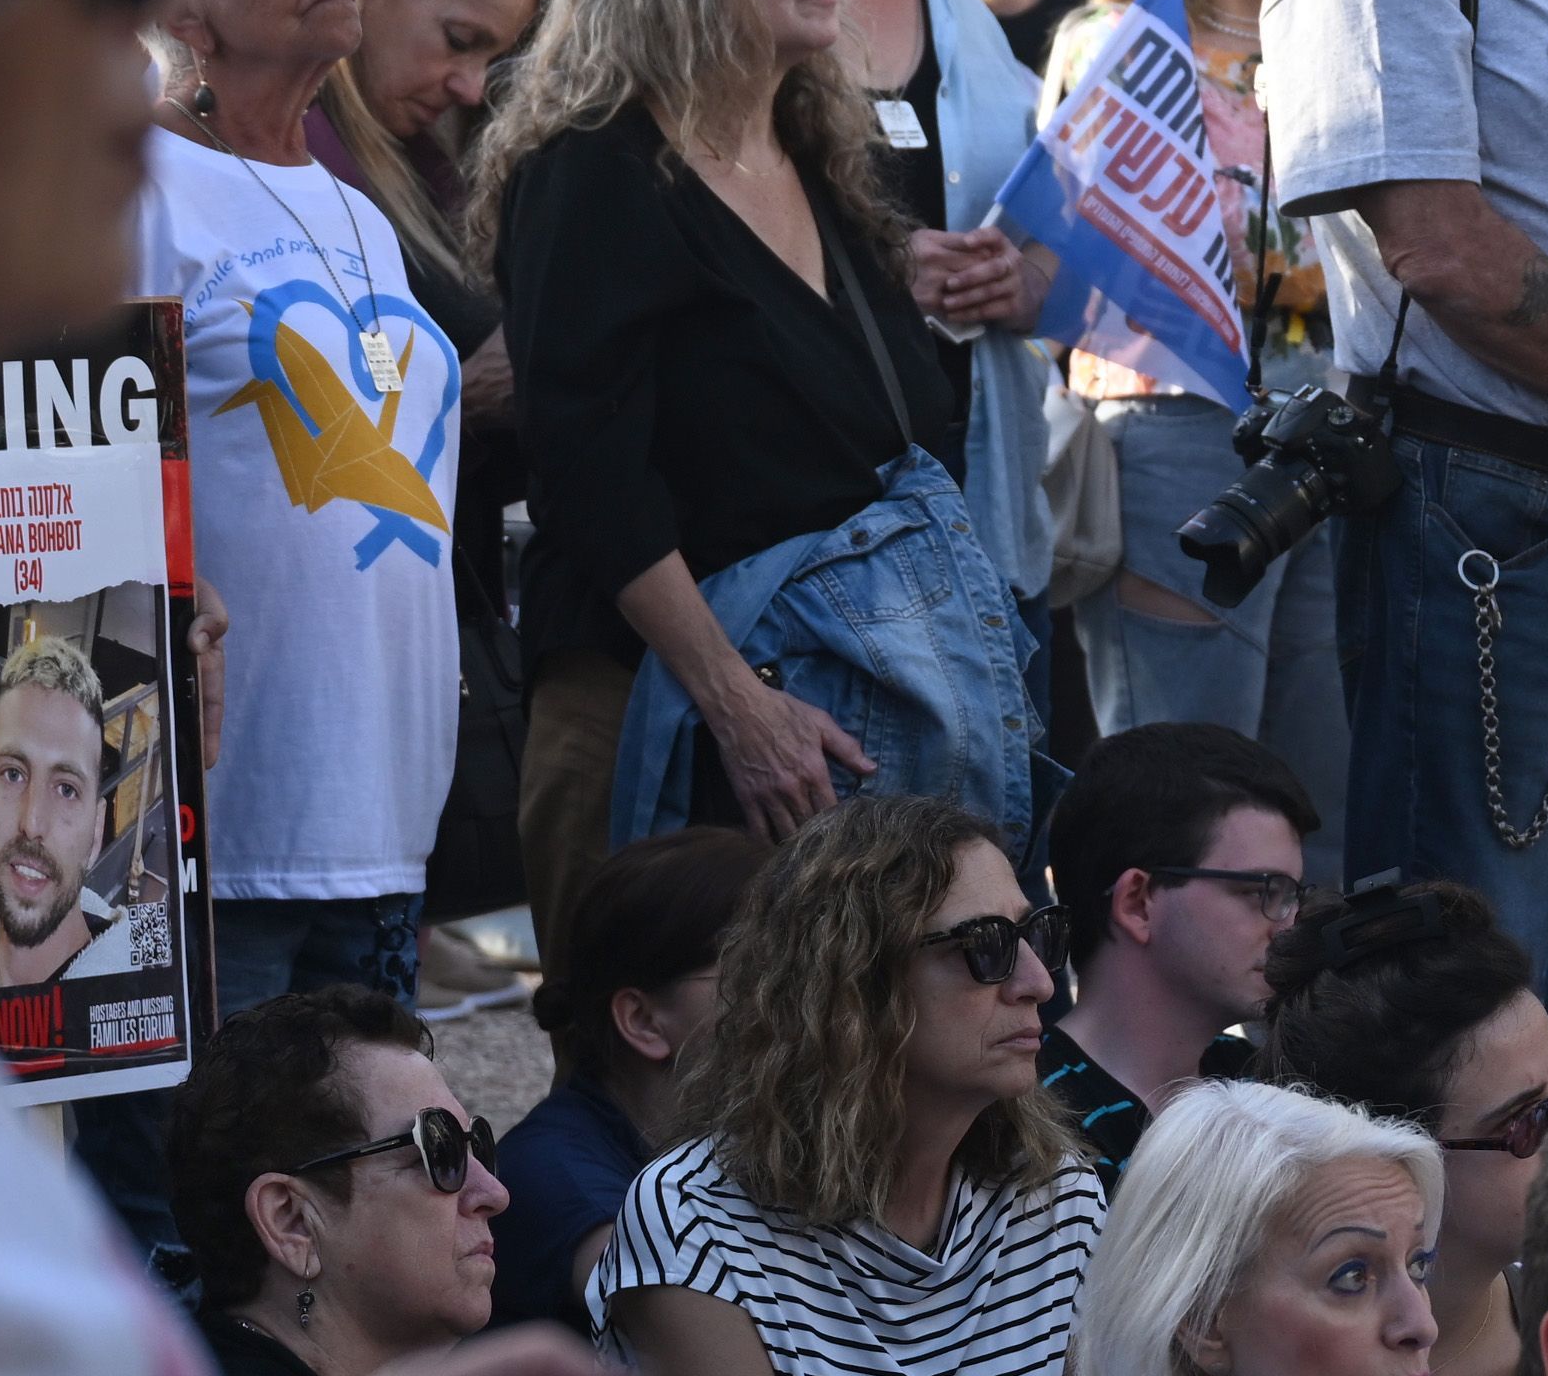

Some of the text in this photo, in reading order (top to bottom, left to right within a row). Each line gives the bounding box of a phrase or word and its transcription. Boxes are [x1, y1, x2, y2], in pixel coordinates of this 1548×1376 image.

[27, 482, 74, 519] אלקנה
[28, 520, 82, 553] BOHBOT
[14, 557, 44, 595] (34)
[89, 995, 174, 1023] HOSTAGES AND MISSING
[90, 1013, 176, 1049] FAMILIES FORUM
